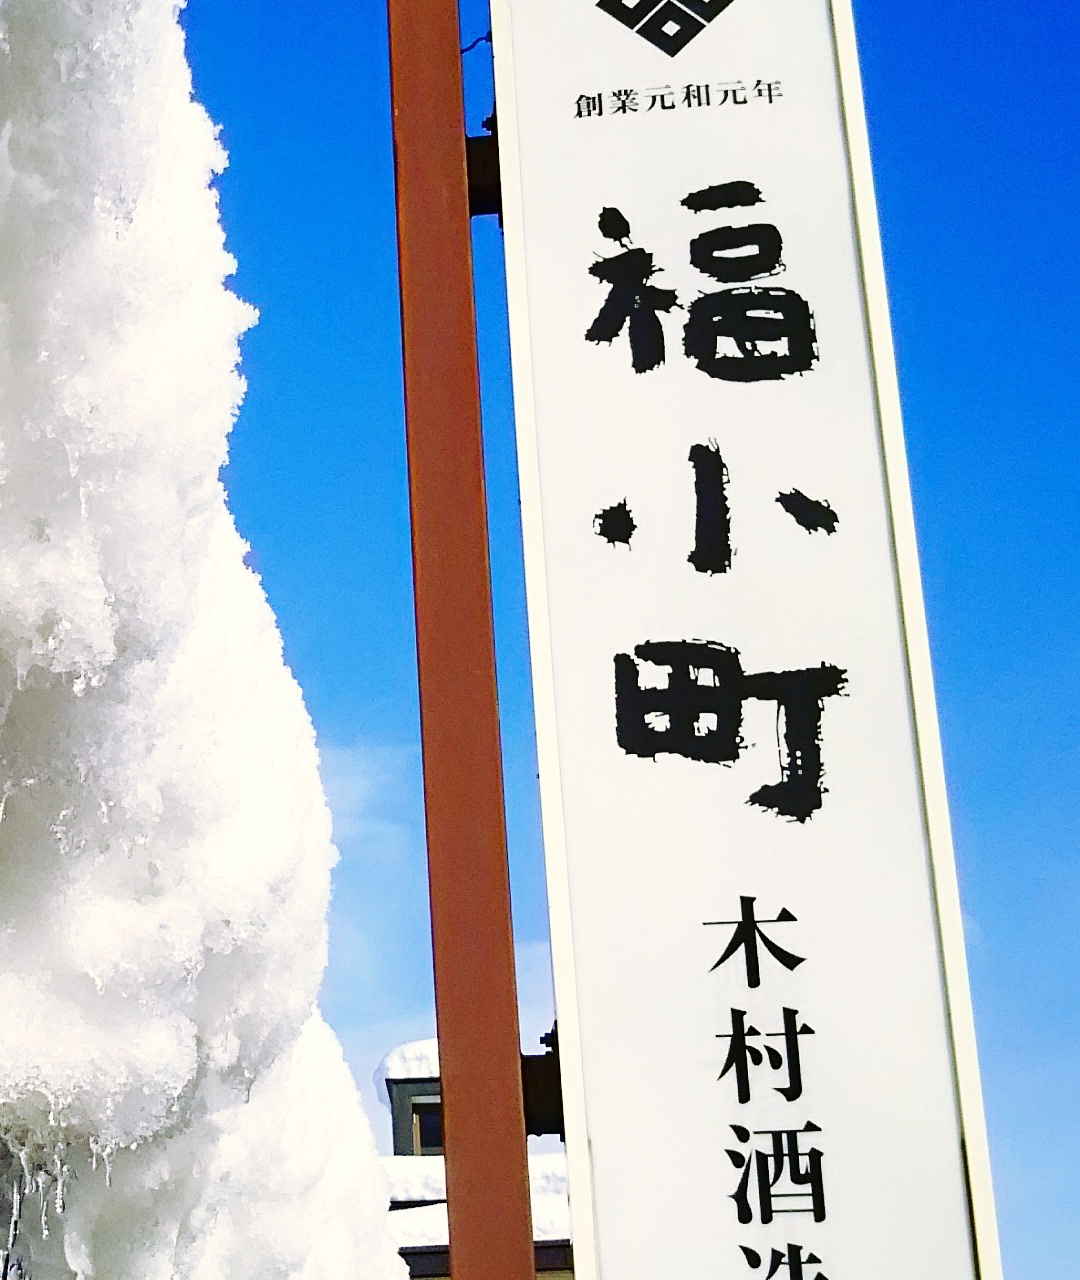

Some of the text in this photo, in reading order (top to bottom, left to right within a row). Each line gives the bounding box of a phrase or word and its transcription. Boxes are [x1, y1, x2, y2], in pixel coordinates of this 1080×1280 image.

[573, 79, 784, 119] 創業元和元年
[584, 180, 850, 823] 福小町
